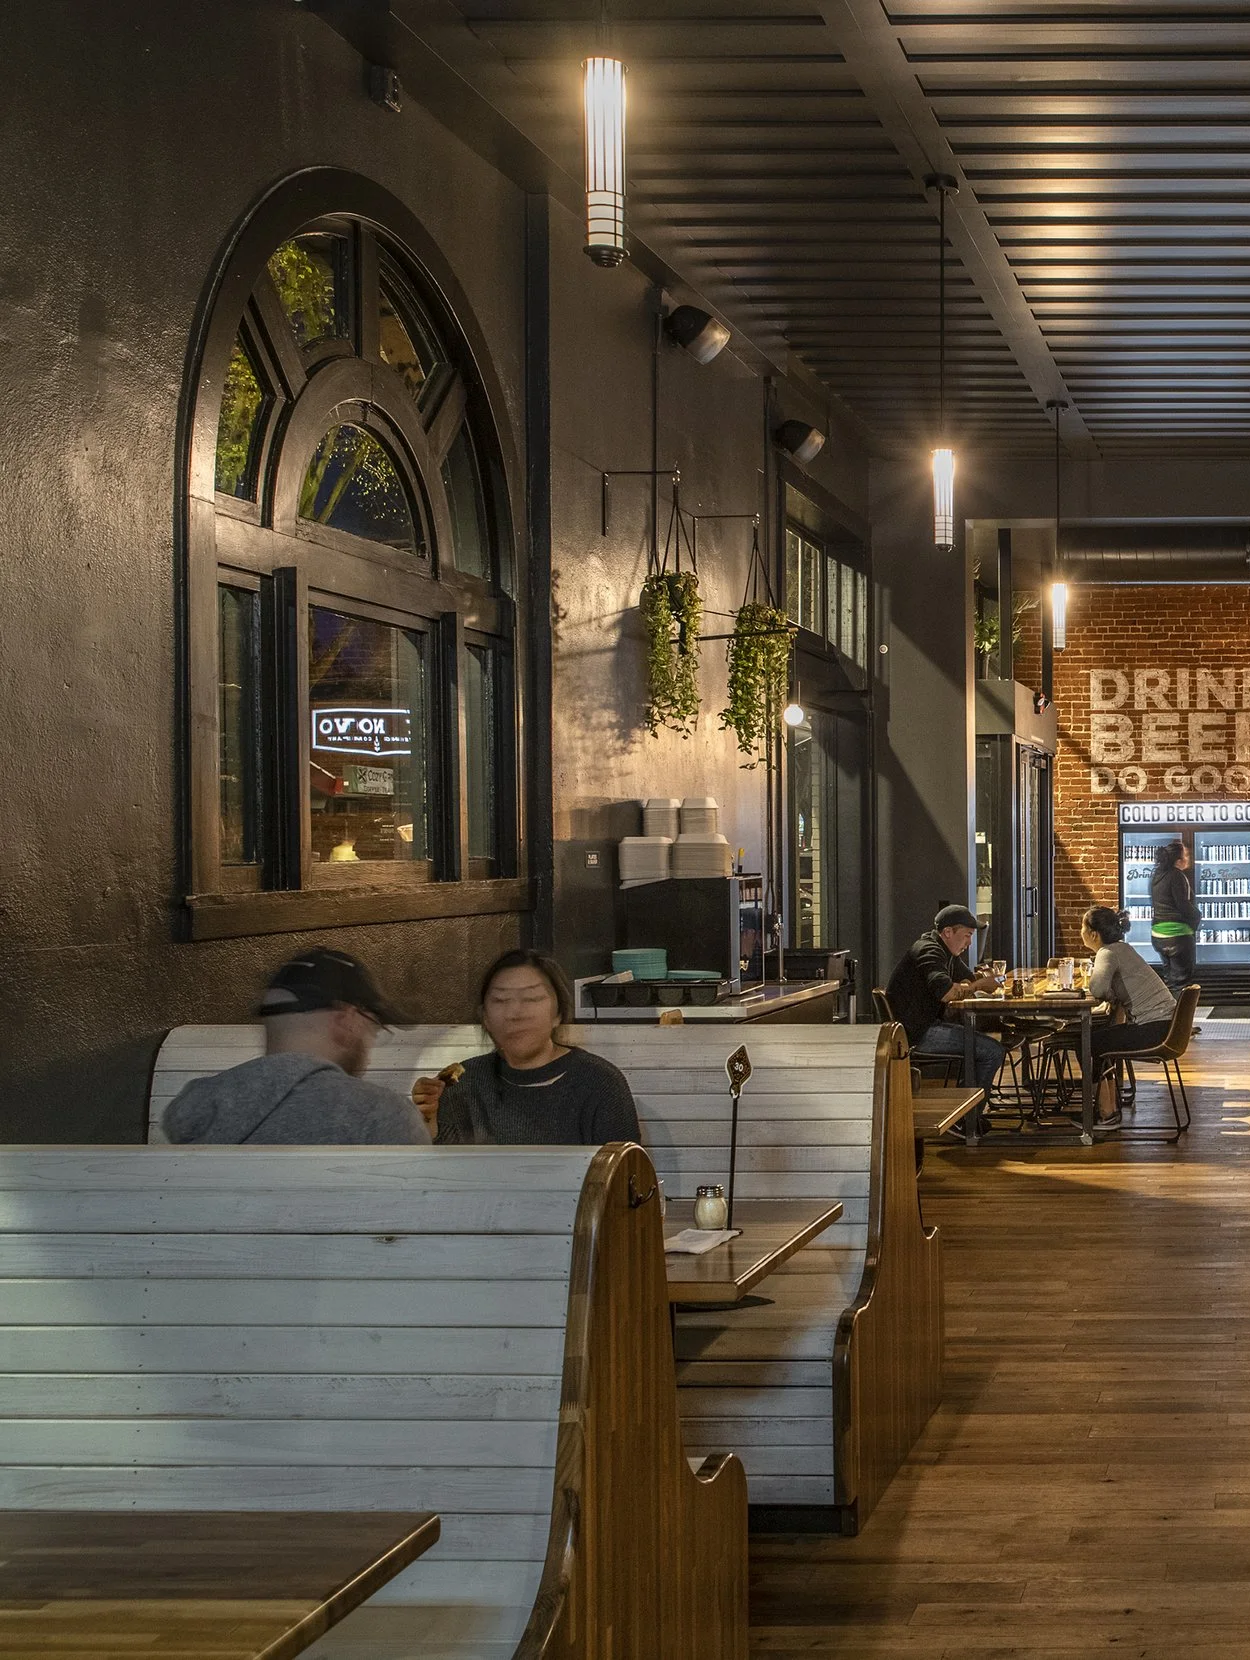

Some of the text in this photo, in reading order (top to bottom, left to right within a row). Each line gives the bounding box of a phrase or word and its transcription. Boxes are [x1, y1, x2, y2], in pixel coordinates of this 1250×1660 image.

[1091, 766, 1147, 793] DO
[1121, 805, 1161, 822] COLD
[1166, 804, 1205, 822] BEER
[1210, 804, 1228, 822] TO
[1200, 868, 1216, 880] Do
[734, 1062, 744, 1072] 30
